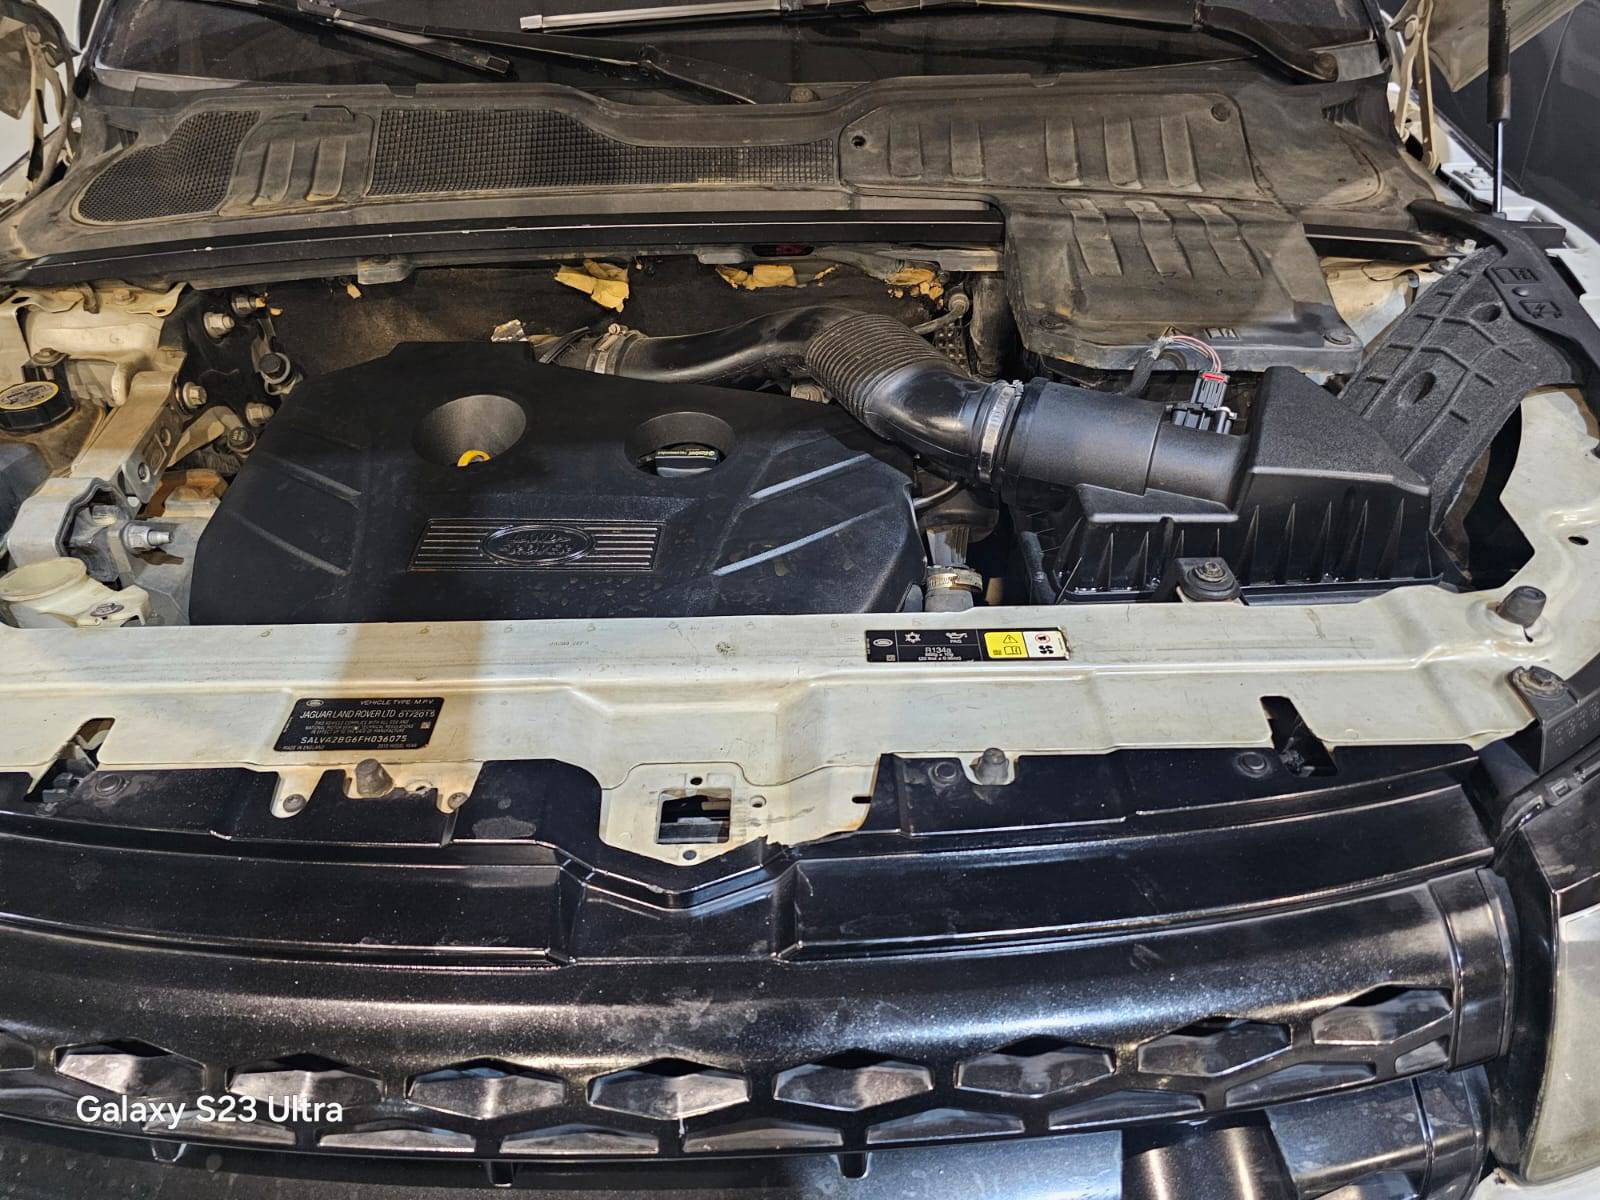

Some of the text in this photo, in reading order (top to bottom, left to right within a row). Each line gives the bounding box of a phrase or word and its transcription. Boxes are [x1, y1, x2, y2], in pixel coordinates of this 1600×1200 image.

[299, 709, 397, 719] JAGUAR LAND ROVER LTD
